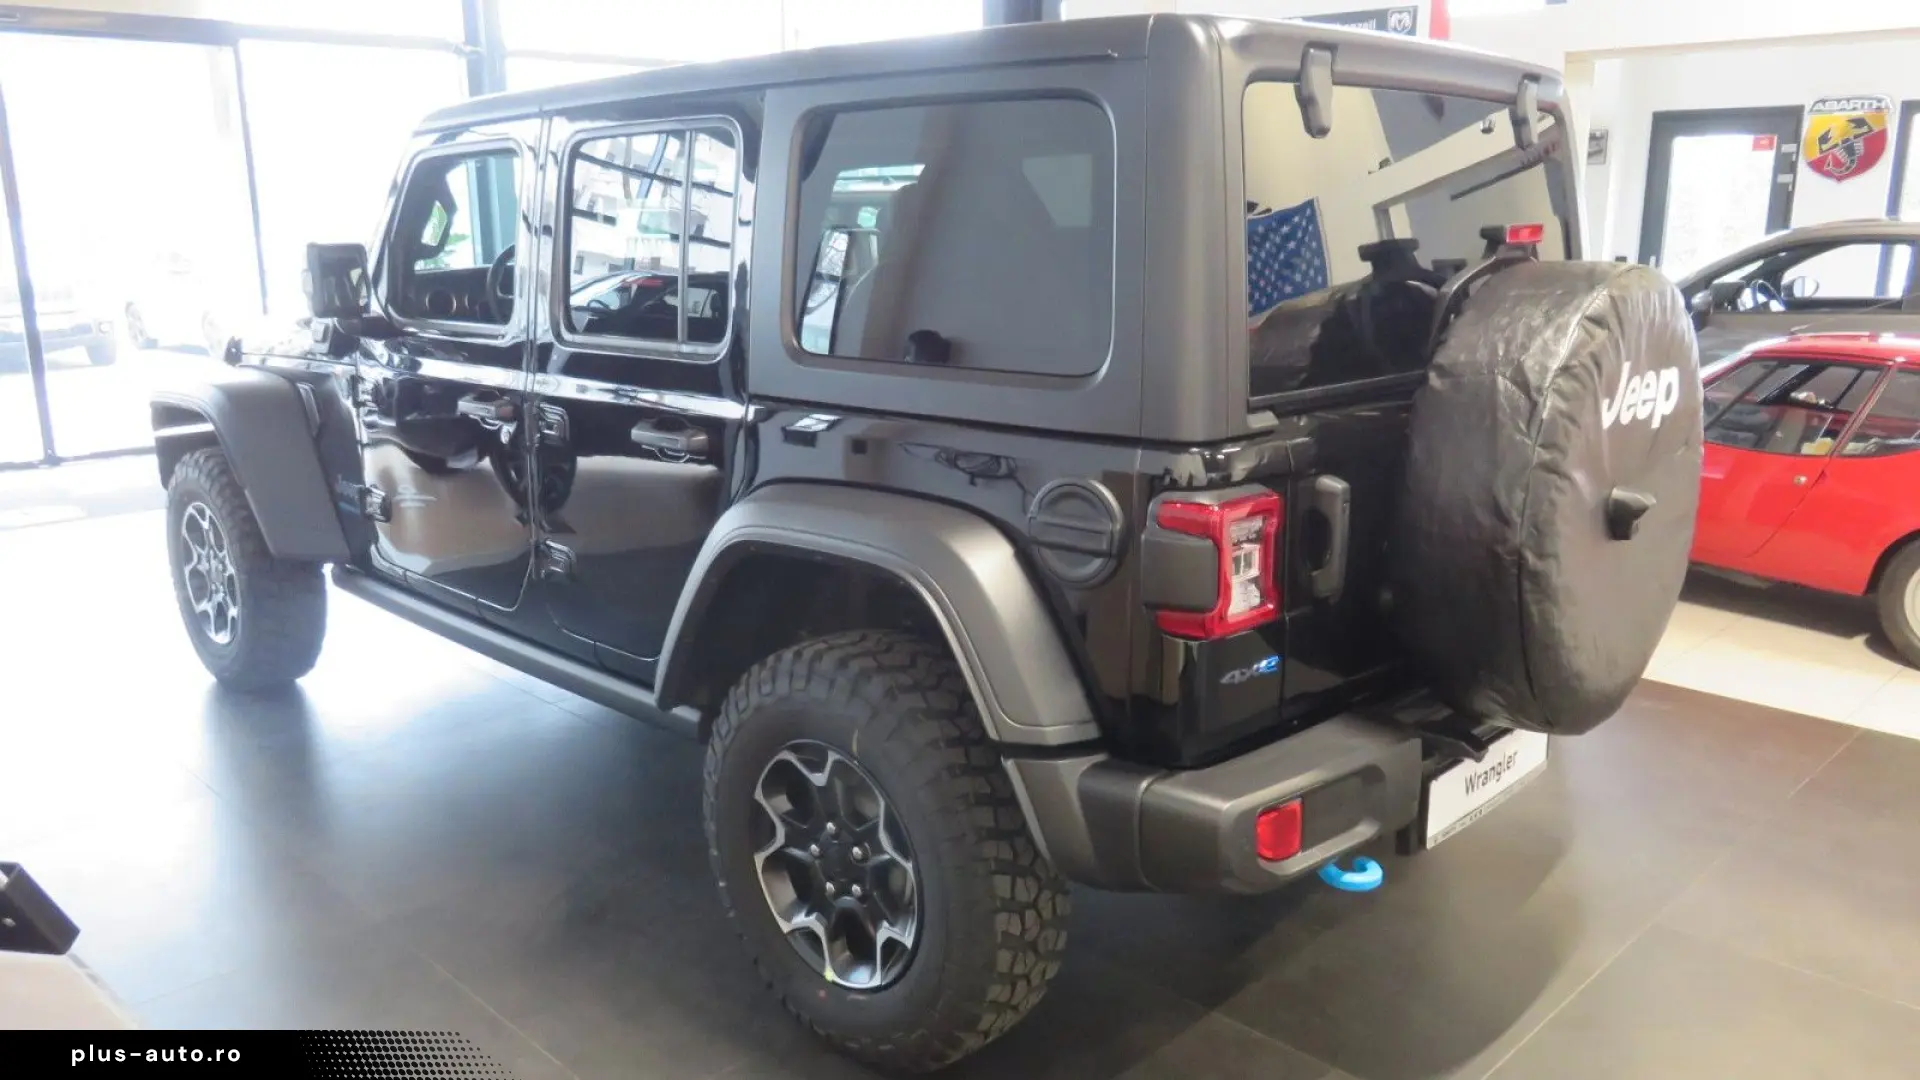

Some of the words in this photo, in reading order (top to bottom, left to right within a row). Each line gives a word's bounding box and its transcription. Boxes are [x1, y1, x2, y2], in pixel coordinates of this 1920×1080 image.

[1811, 99, 1889, 111] ABARTH
[1601, 360, 1680, 430] Jeep
[1464, 750, 1518, 797] Wrangler
